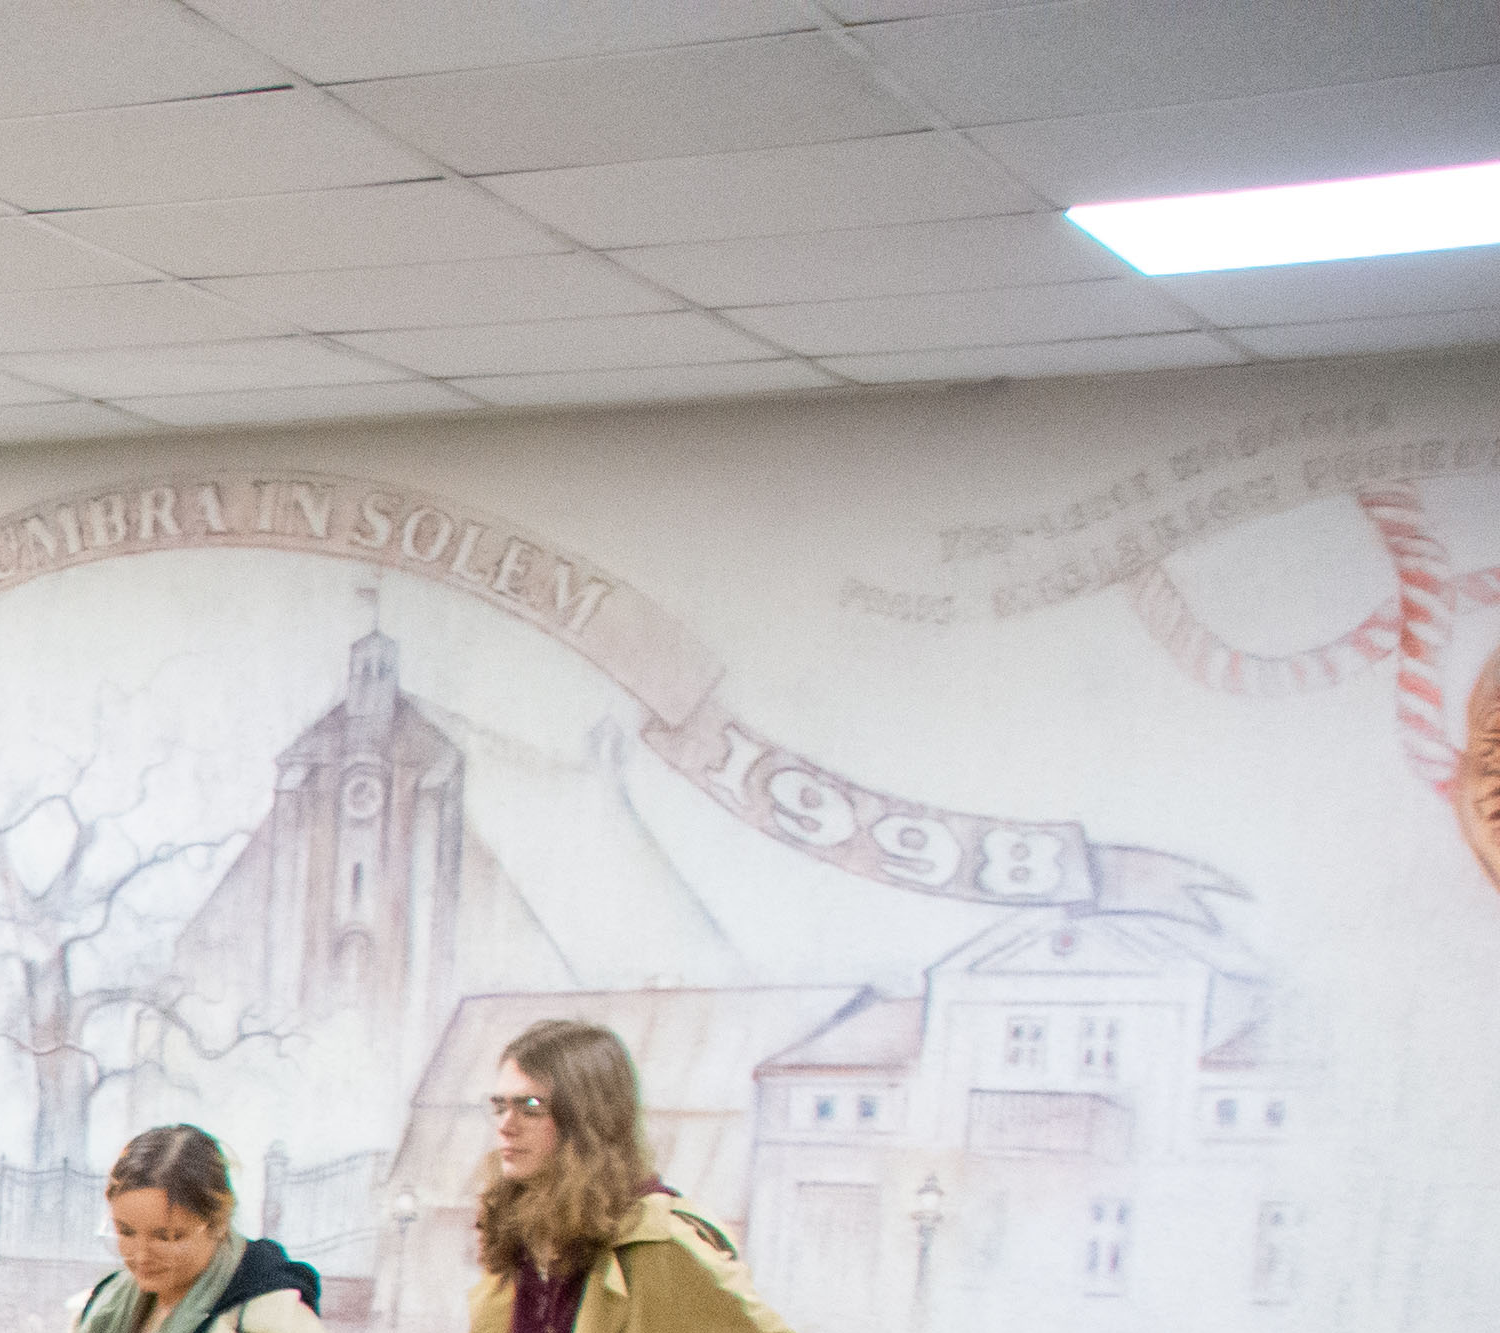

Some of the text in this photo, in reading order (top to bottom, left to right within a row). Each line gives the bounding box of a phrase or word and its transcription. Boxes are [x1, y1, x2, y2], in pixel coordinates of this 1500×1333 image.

[252, 480, 331, 540] IN
[352, 491, 617, 639] SOLEM
[701, 721, 1063, 896] 1998
